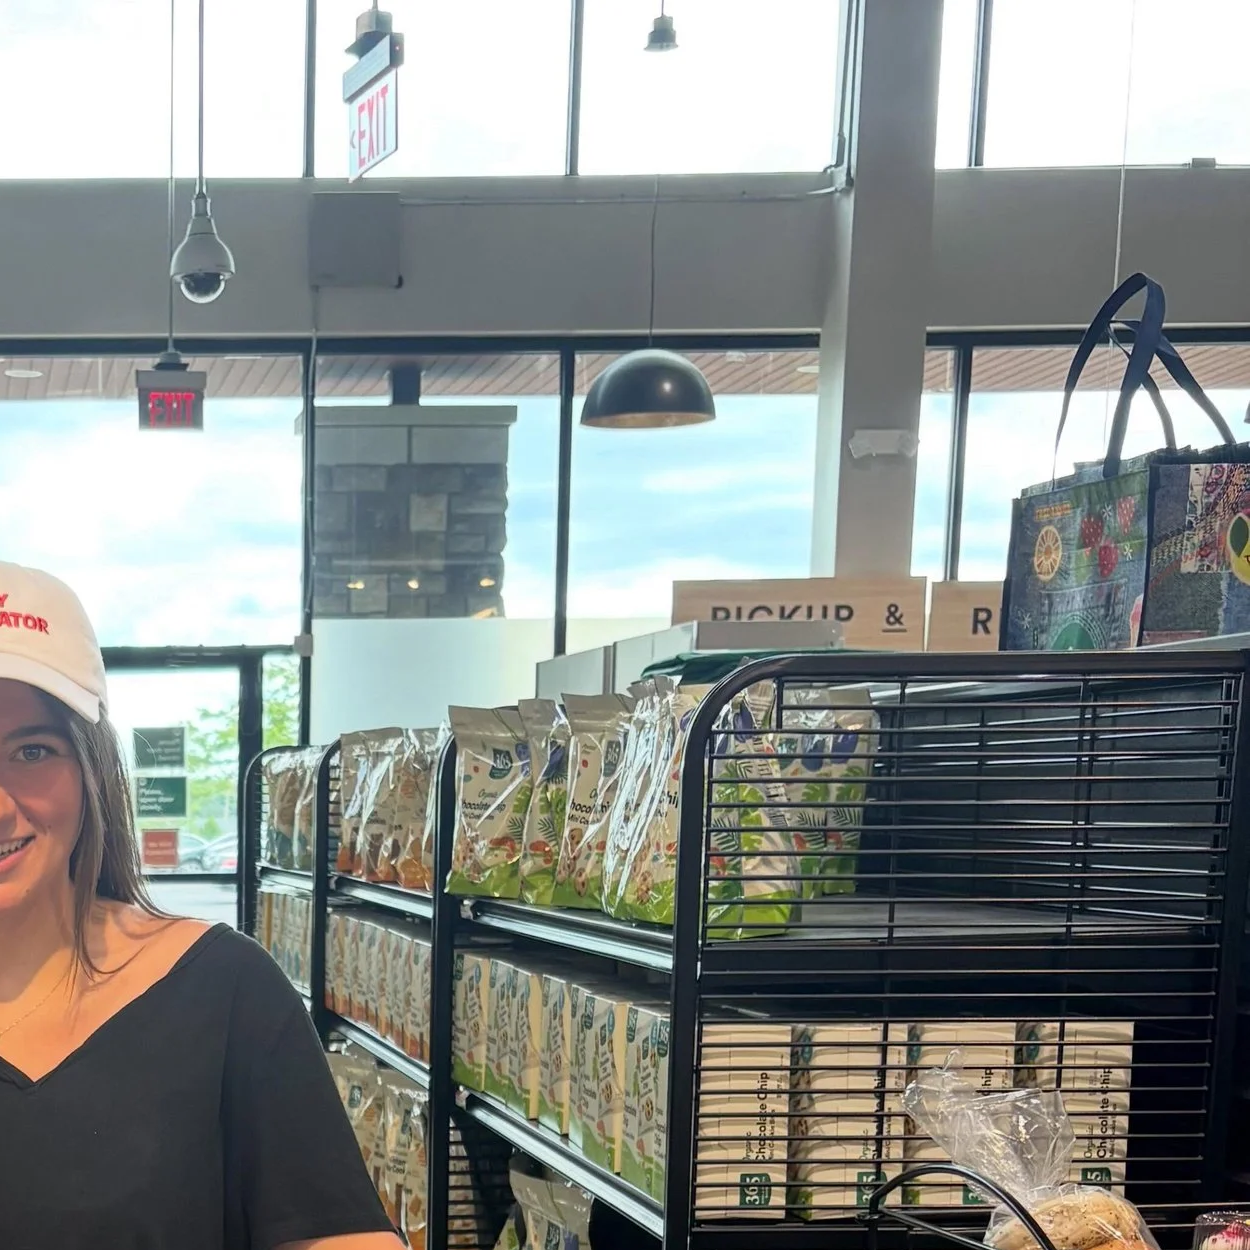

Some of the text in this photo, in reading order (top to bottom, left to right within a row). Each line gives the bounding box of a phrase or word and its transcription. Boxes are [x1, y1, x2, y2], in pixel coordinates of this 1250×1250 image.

[358, 84, 388, 169] EXIT
[149, 392, 195, 429] EXIT
[885, 603, 904, 626] &
